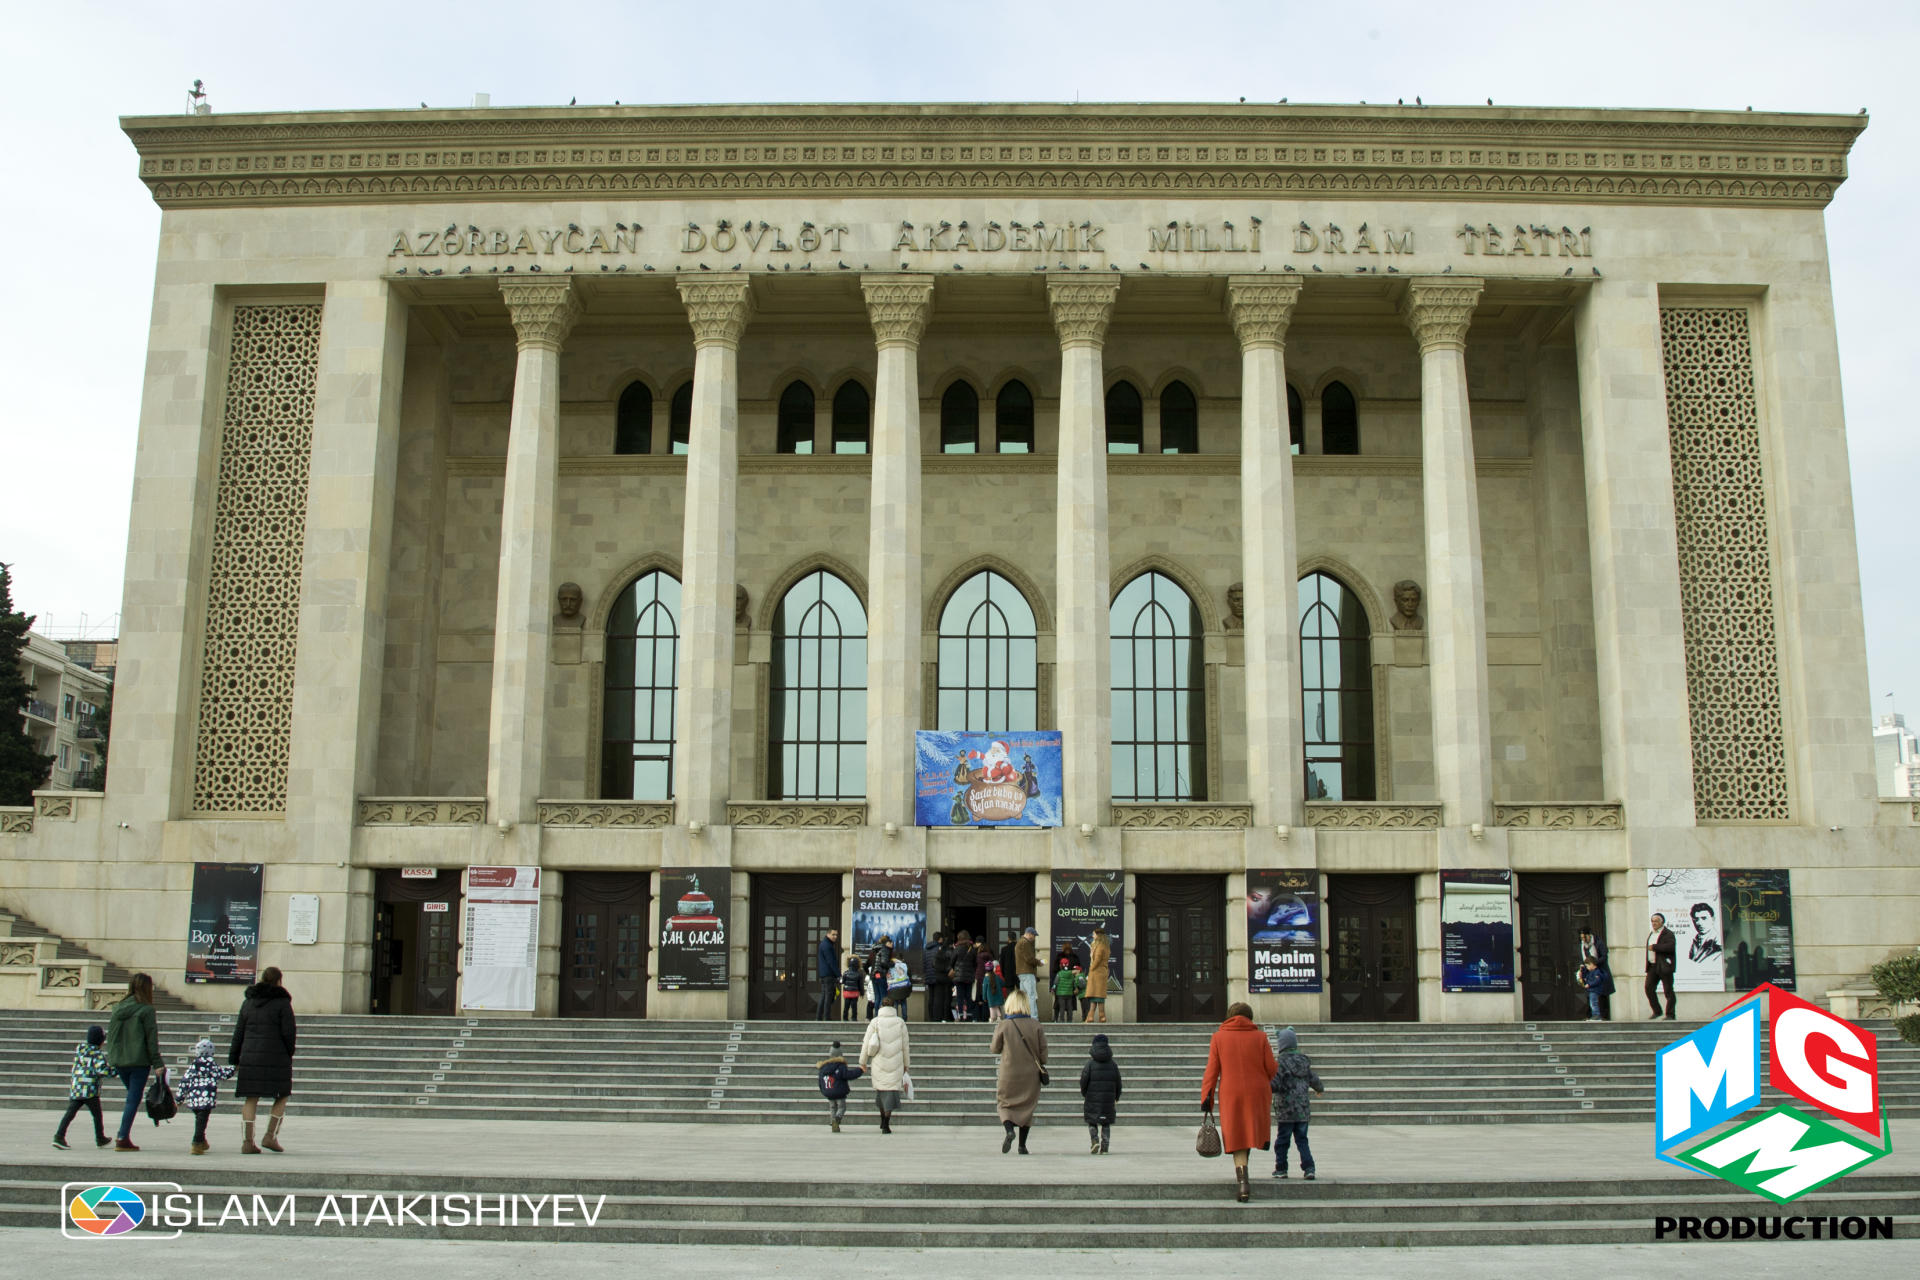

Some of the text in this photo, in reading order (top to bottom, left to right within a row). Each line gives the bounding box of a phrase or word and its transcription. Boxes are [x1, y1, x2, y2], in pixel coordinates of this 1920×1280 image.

[388, 229, 637, 257] AZƏRBAYCAN
[680, 219, 849, 253] DÖVLƏT
[893, 221, 1105, 252] AKADEMİK
[1292, 226, 1415, 254] DRAM
[1456, 229, 1593, 257] TEATRI
[404, 868, 433, 876] KASSA
[858, 890, 921, 899] CƏHƏNNƏM
[860, 900, 919, 911] SAKİNLƏRİ
[191, 929, 256, 949] Boy çiçəyi
[688, 930, 725, 946] QACAR
[1255, 950, 1315, 964] Mənim
[1254, 966, 1316, 980] günahım
